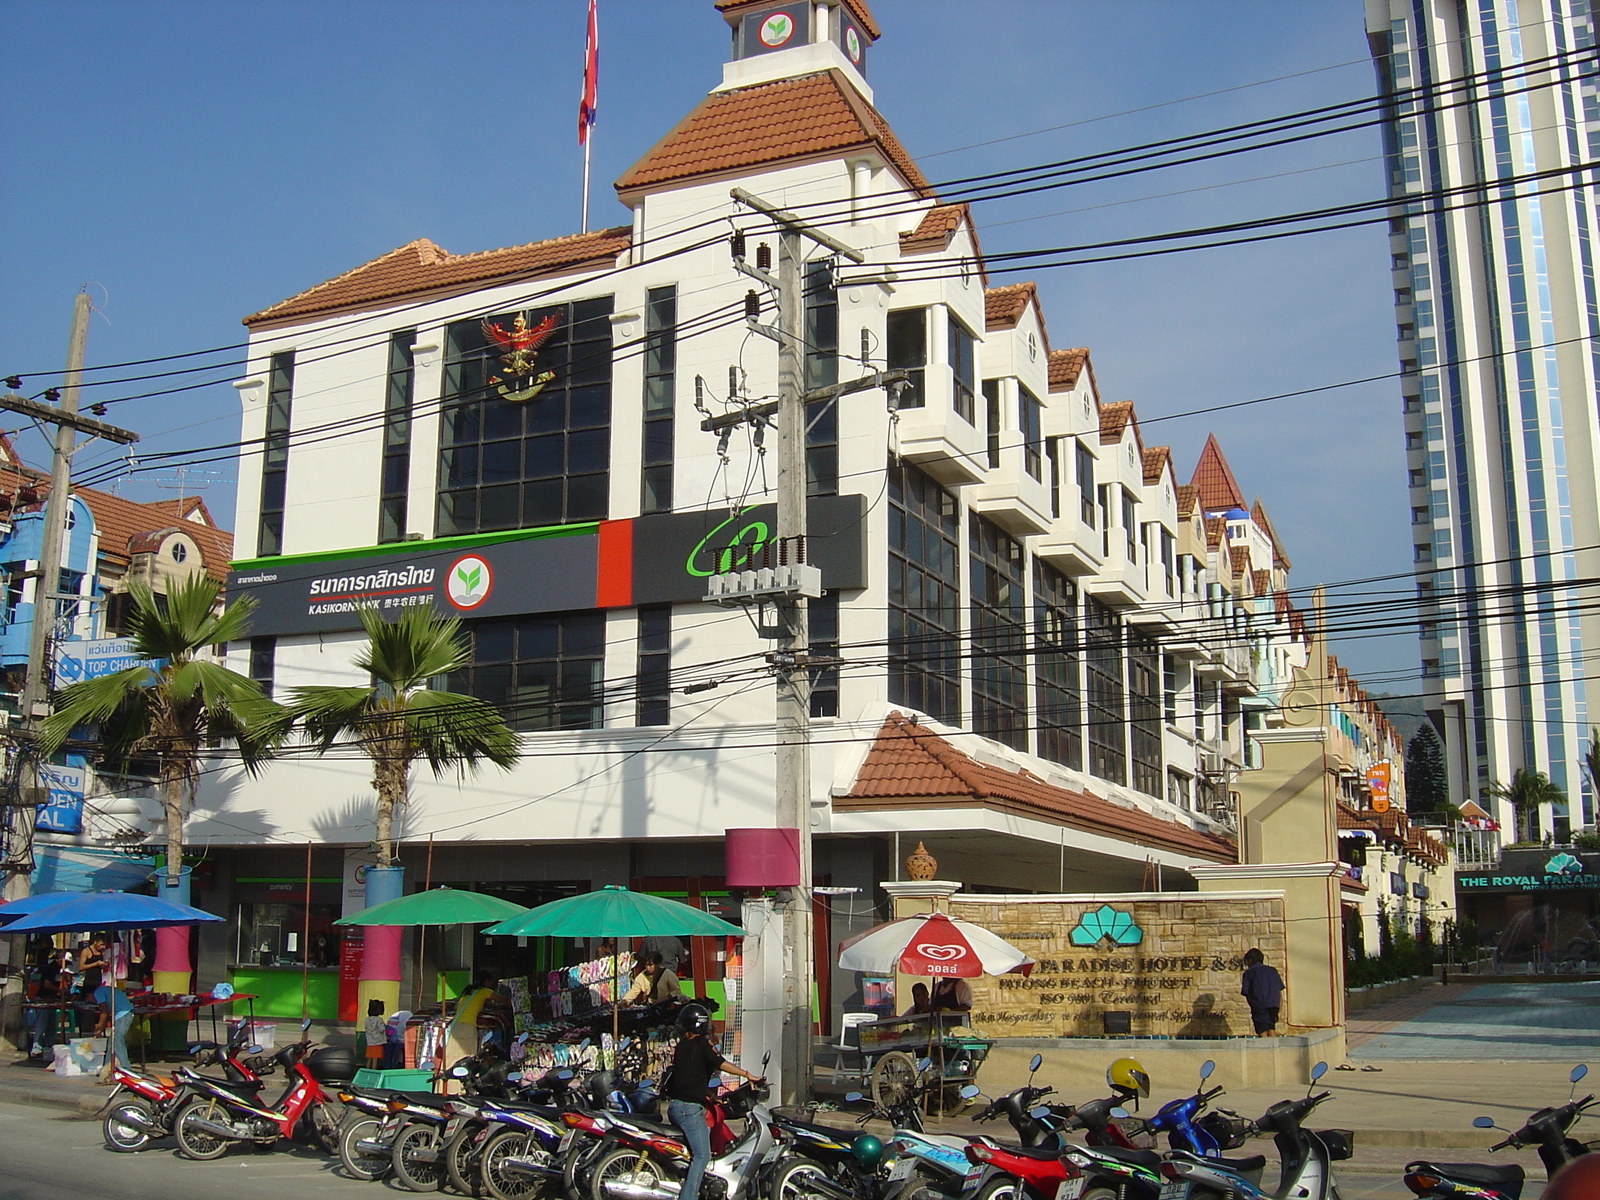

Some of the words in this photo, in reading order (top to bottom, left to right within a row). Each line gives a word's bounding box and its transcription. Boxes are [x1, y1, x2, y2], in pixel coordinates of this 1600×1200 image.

[309, 565, 435, 595] ธนาคารกสิกรไทย
[88, 660, 107, 673] TOP
[1459, 877, 1488, 887] THE
[1492, 876, 1540, 886] ROYAL
[1543, 874, 1600, 885] PARADI
[927, 963, 958, 974] วอลล์
[1040, 957, 1134, 974] PARADISE
[1141, 956, 1208, 973] HOTEL
[1210, 956, 1227, 972] &
[1228, 955, 1248, 972] SP
[999, 977, 1057, 990] PATONG
[1060, 976, 1112, 989] BEACH
[1123, 976, 1193, 990] PHUKET
[1040, 992, 1064, 1005] ISO
